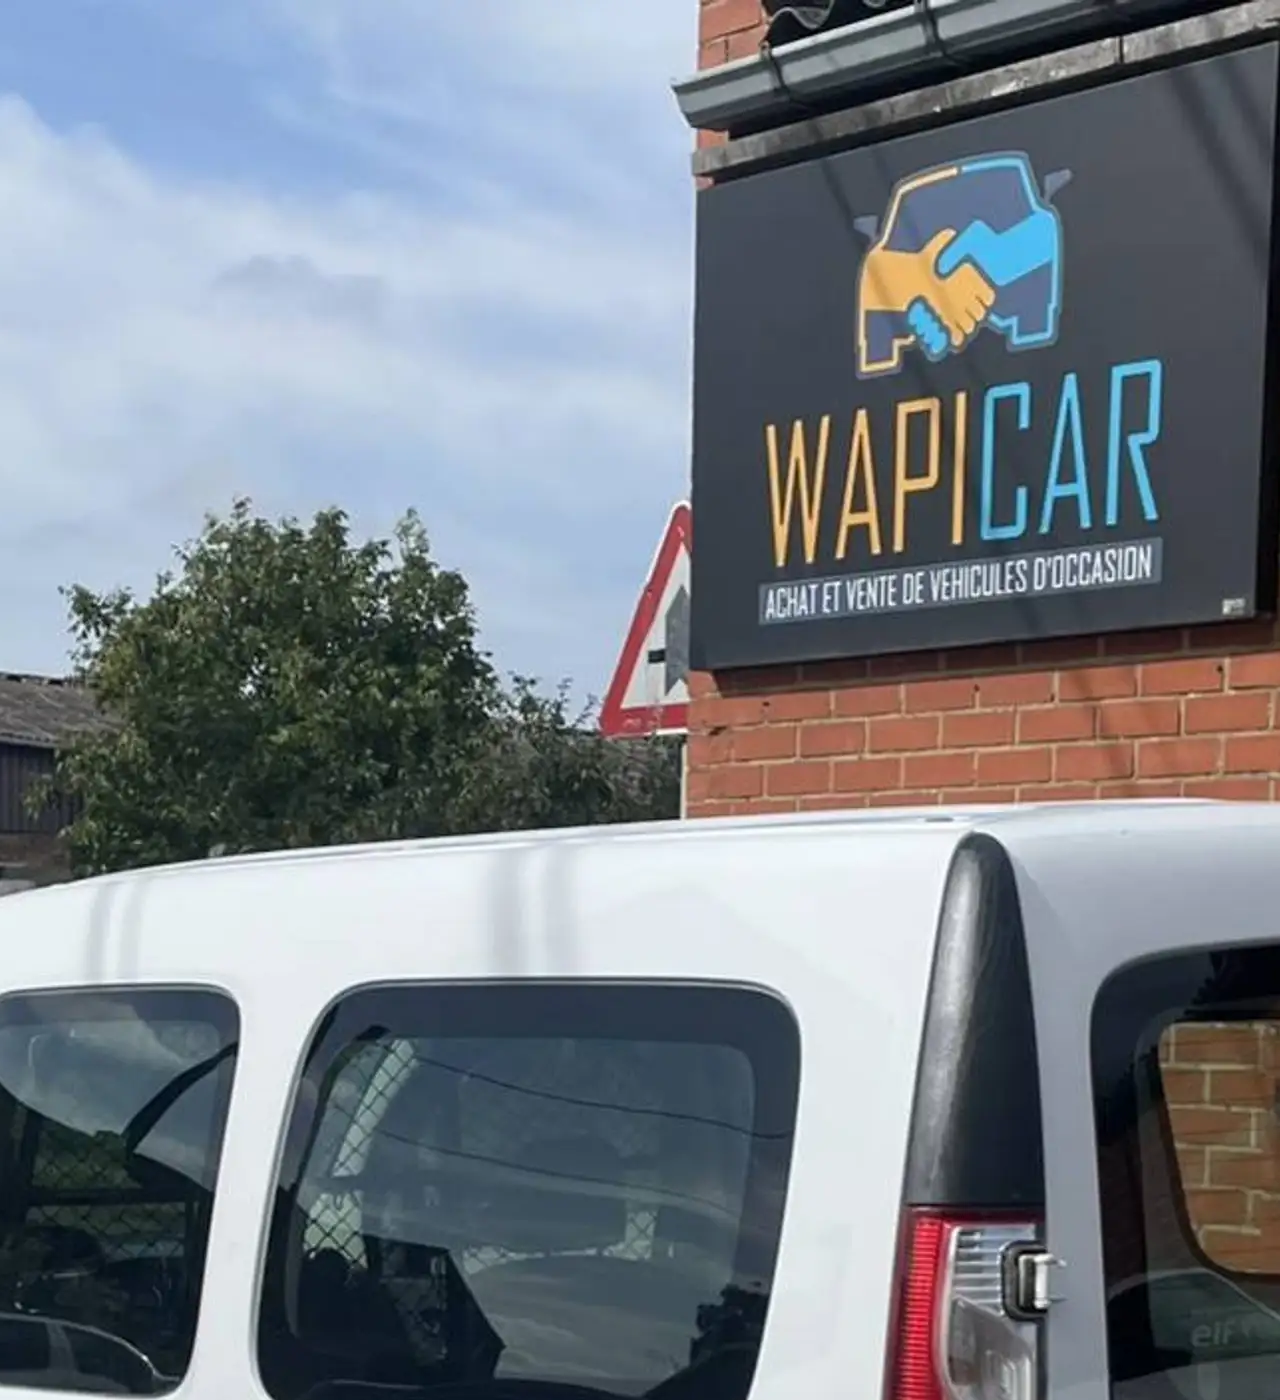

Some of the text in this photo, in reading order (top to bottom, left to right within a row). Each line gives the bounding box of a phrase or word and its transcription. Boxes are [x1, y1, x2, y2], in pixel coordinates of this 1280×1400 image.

[765, 358, 1163, 568] WAPICAR
[765, 544, 1152, 620] ACHAT ET VENTE DE VEHICULES D'OCCASION
